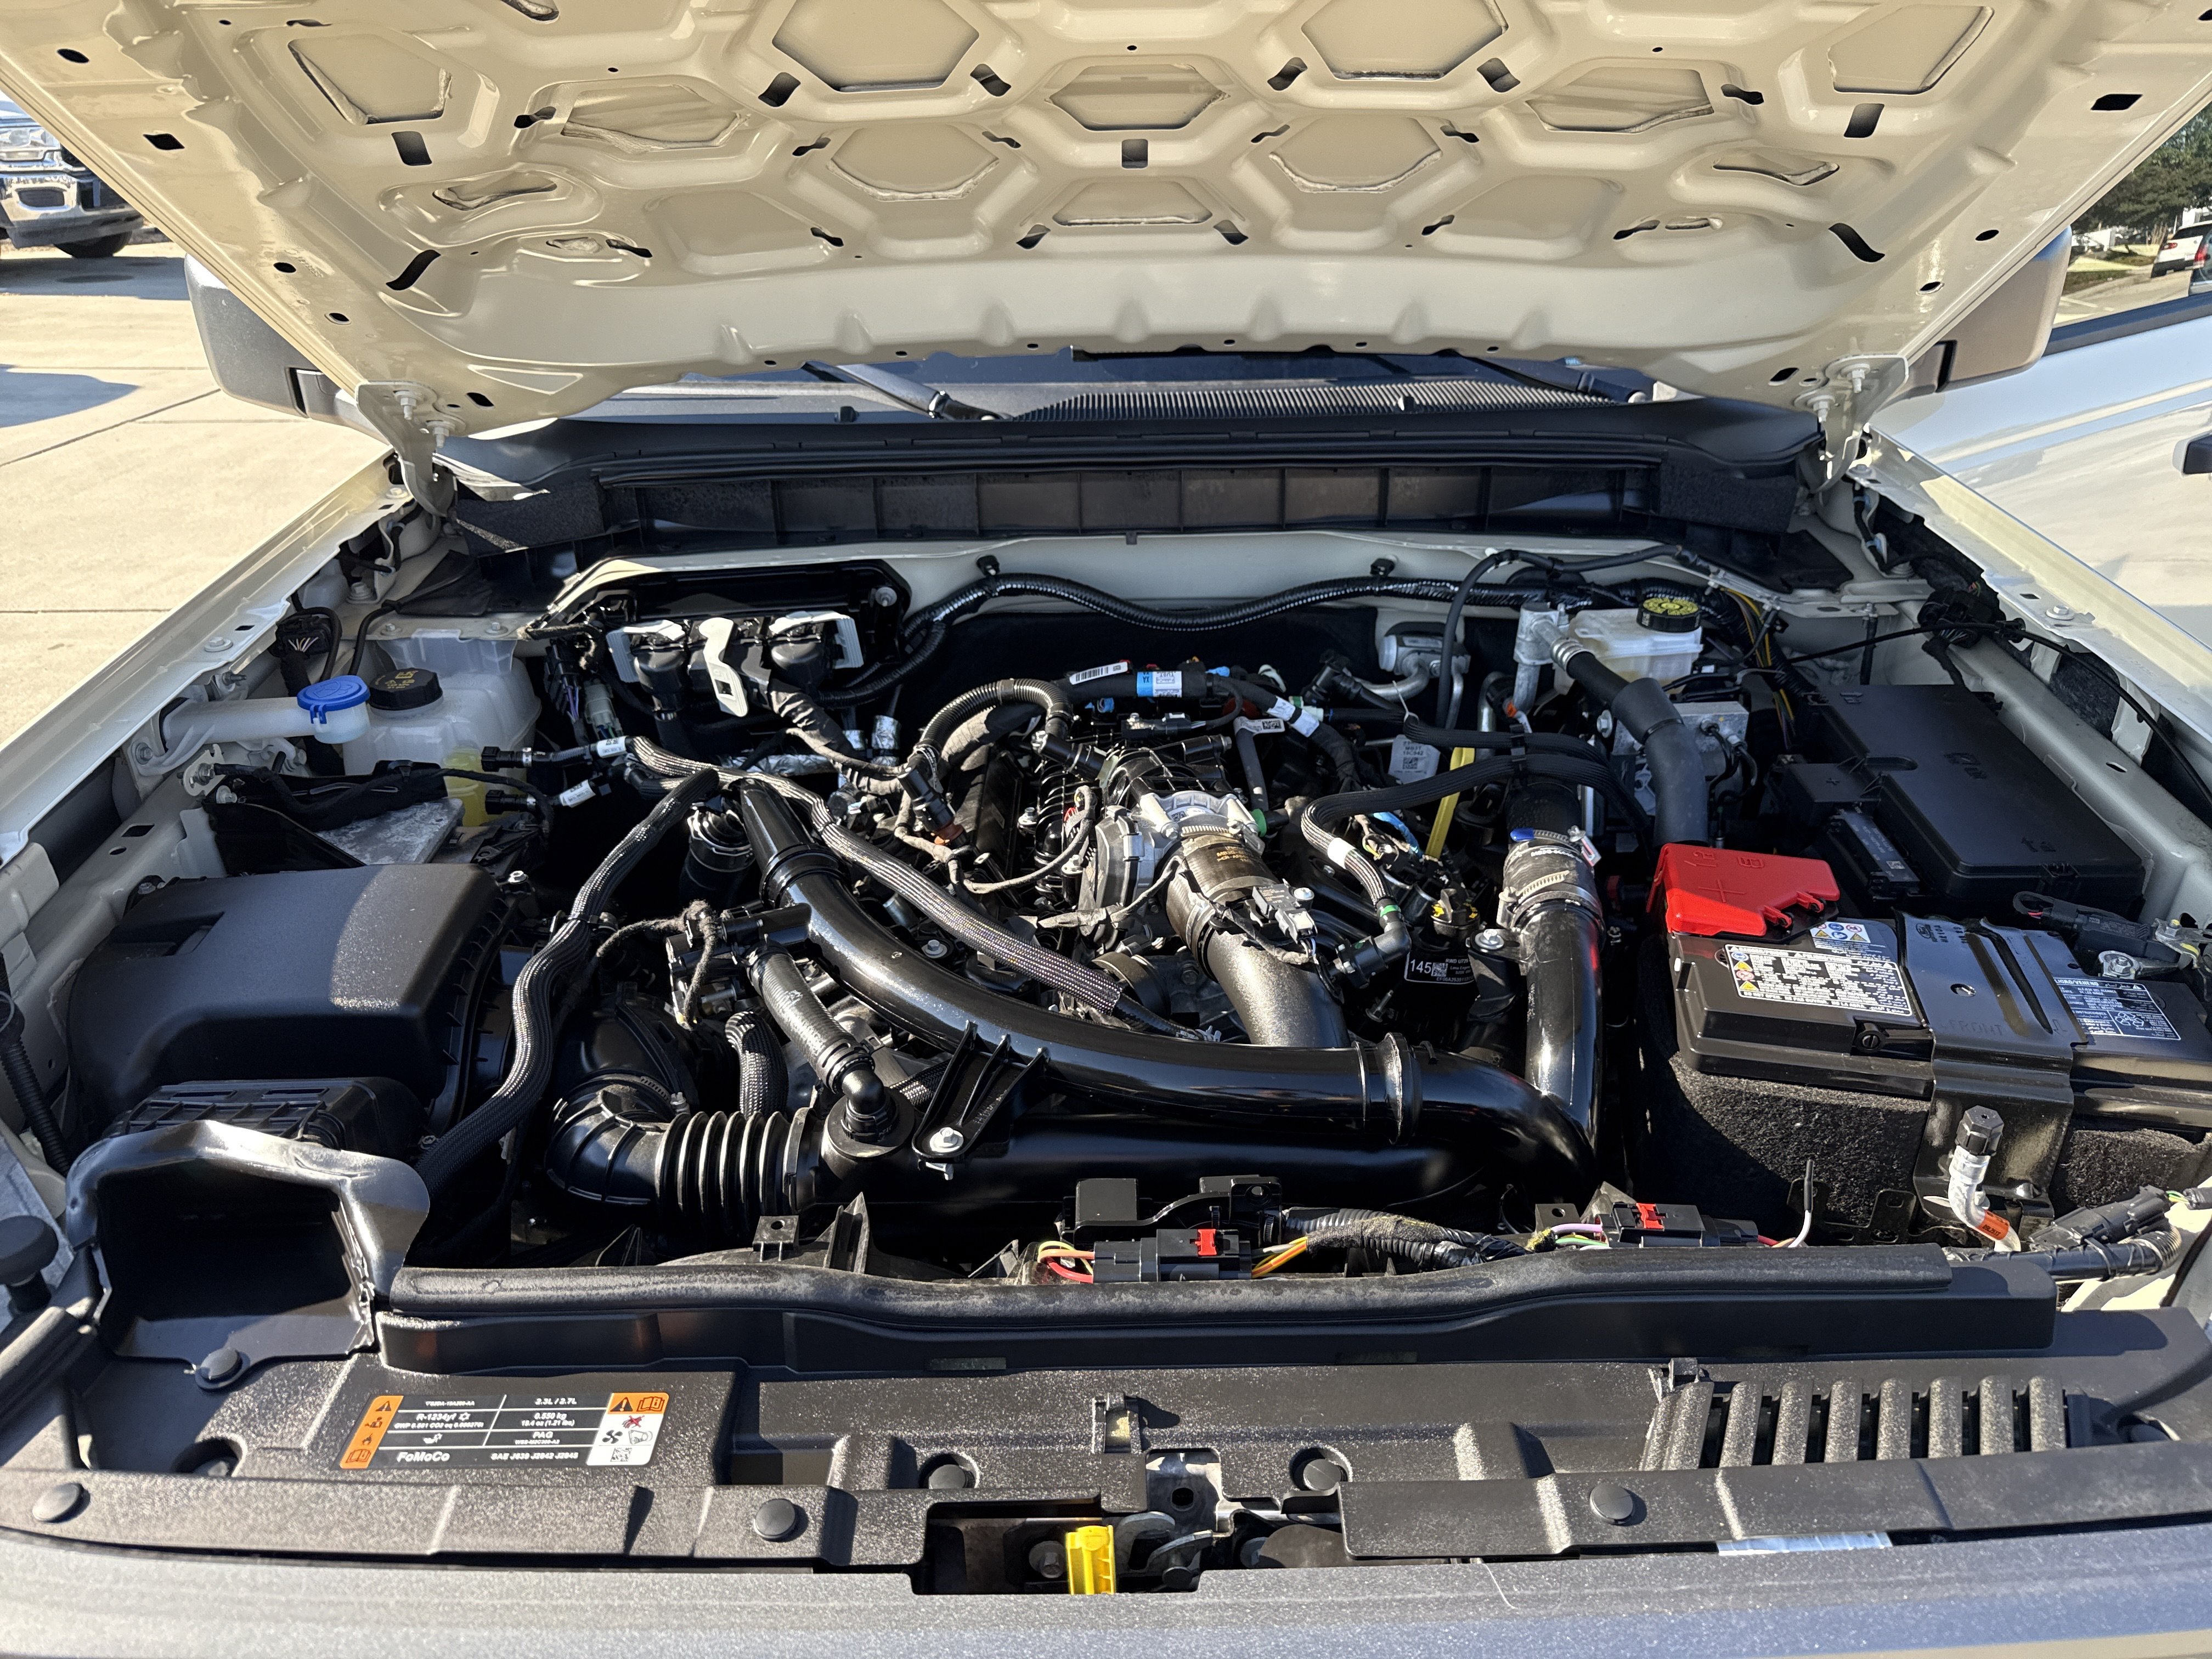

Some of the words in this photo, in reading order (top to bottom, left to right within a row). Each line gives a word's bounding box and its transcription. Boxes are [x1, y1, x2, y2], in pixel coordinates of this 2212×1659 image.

[1410, 959, 1432, 974] 145
[416, 1413, 457, 1422] R-1234yf
[556, 1412, 567, 1421] kg
[396, 1451, 450, 1463] FoMoCo
